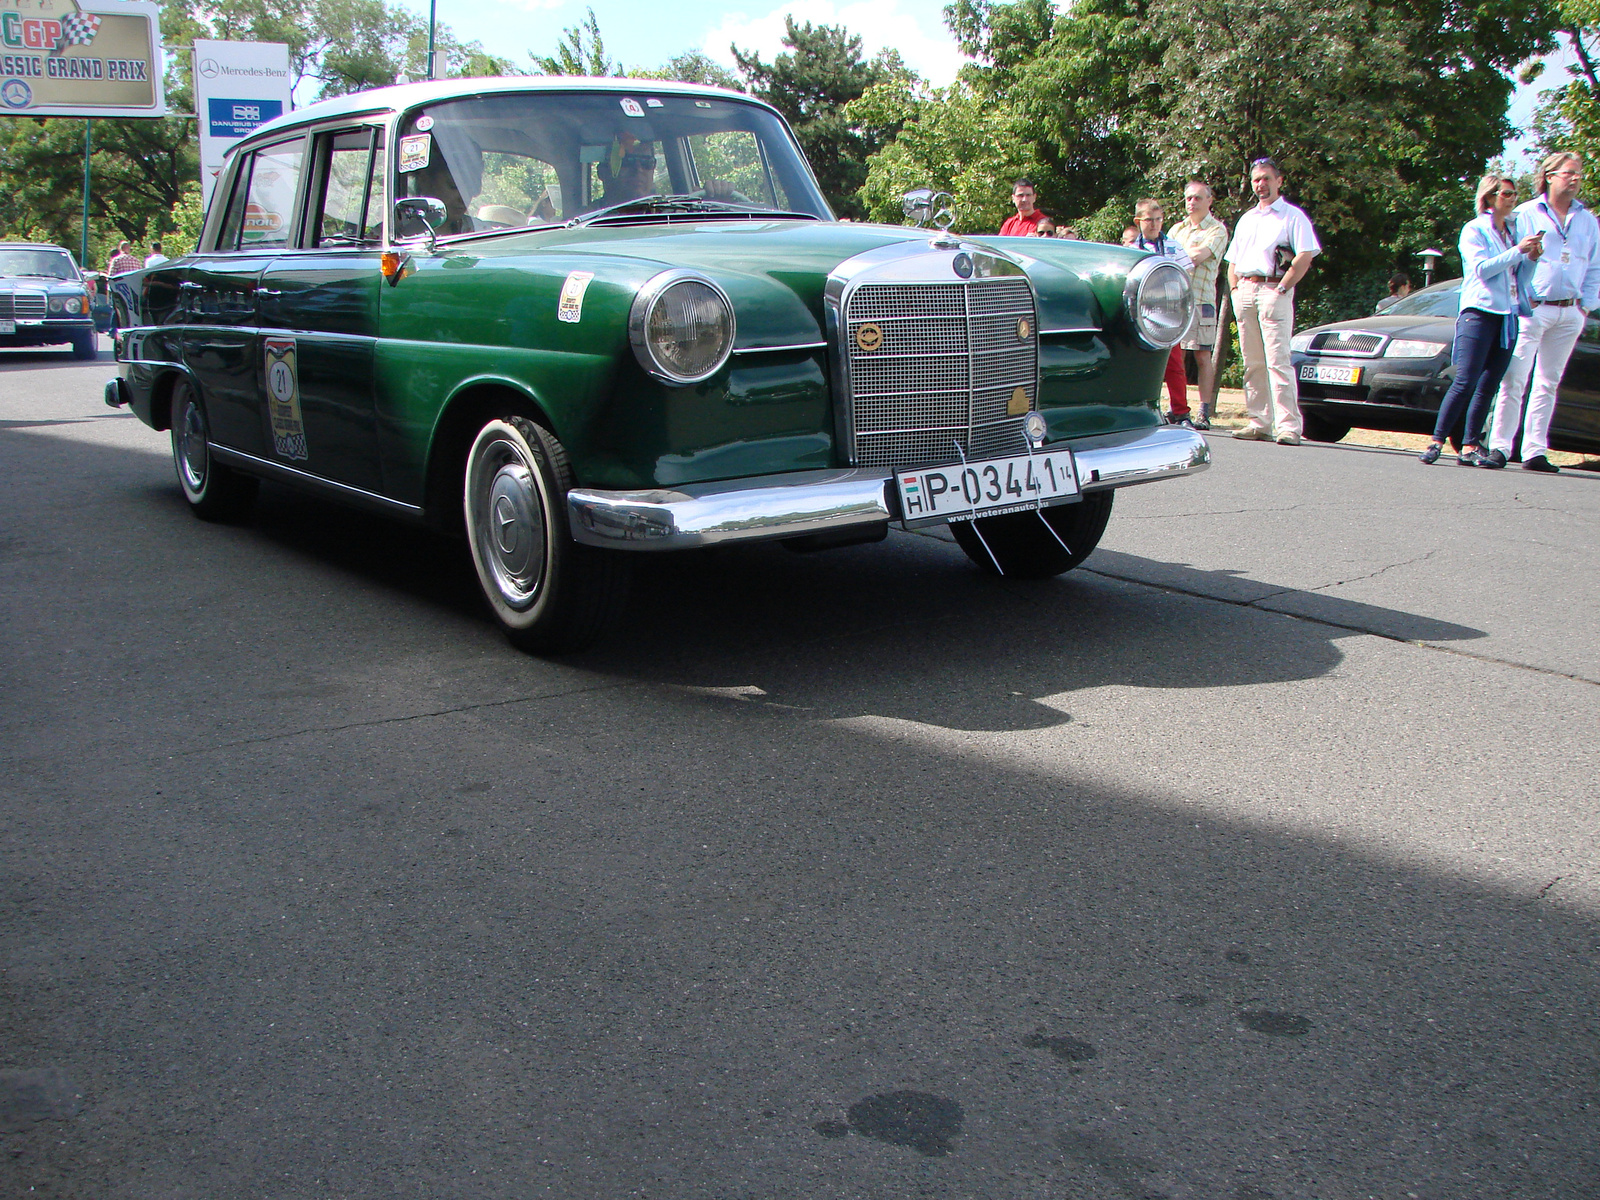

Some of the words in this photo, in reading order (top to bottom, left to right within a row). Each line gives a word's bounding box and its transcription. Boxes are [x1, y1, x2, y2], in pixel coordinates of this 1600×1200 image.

[47, 57, 103, 79] GRAND
[107, 60, 146, 80] PRIX
[221, 65, 287, 77] Mercedes-Benz
[419, 118, 431, 128] 23
[410, 144, 419, 153] 21
[1301, 367, 1315, 379] BB
[276, 369, 287, 394] 21
[906, 495, 923, 514] H
[925, 457, 1057, 512] P-03441
[1060, 466, 1072, 480] 14
